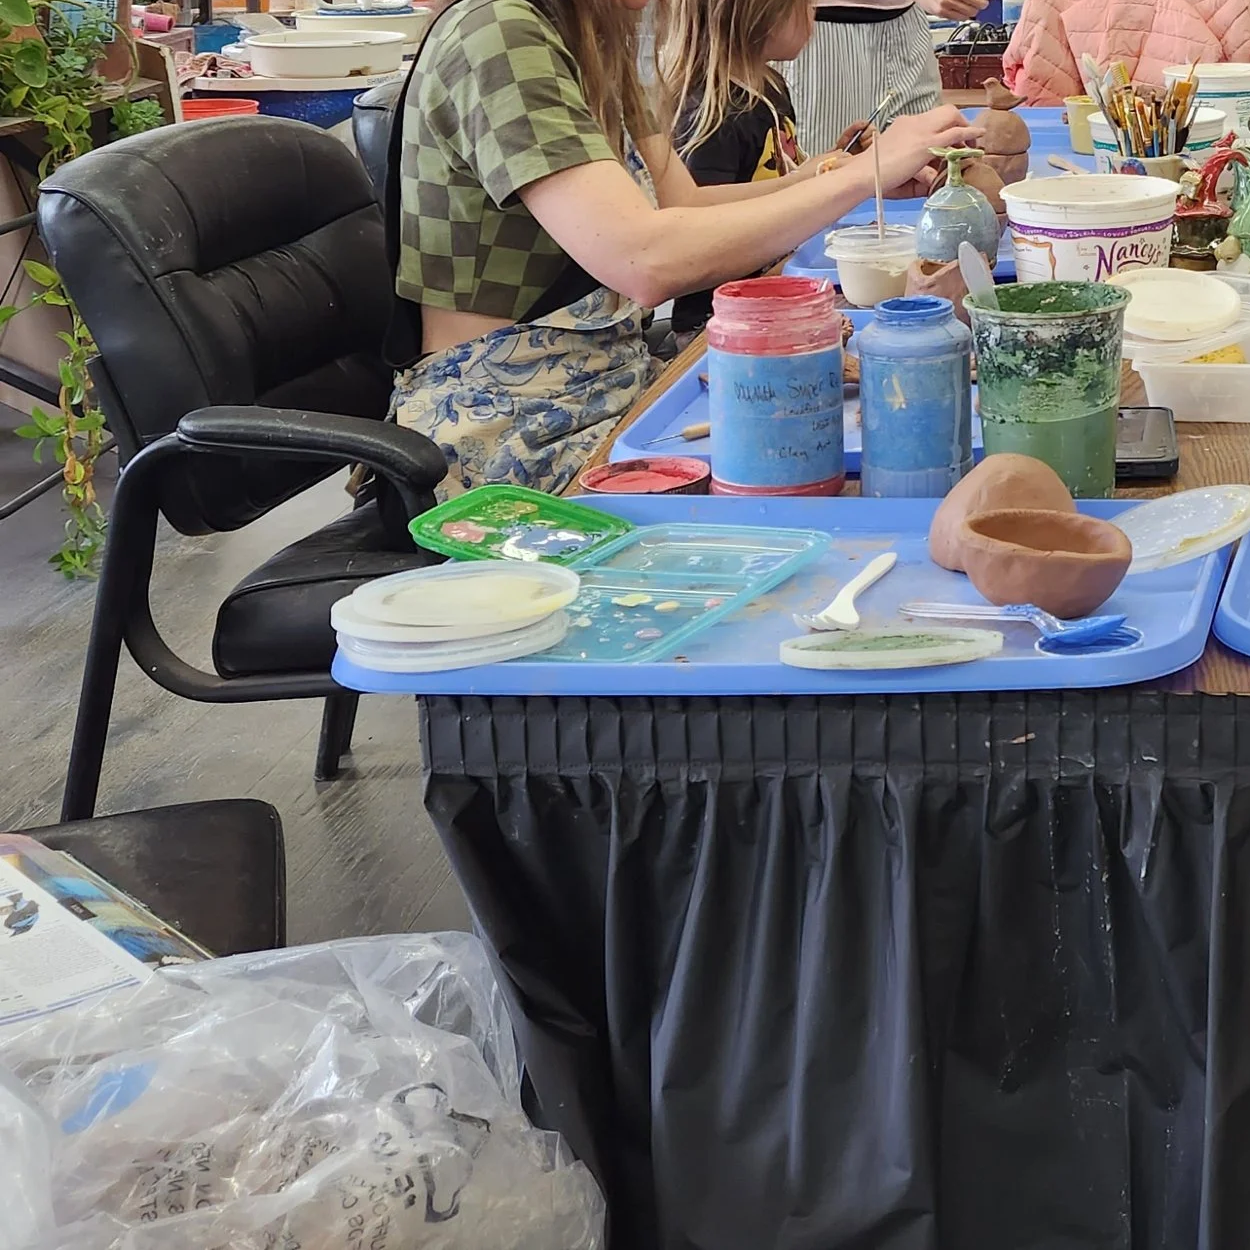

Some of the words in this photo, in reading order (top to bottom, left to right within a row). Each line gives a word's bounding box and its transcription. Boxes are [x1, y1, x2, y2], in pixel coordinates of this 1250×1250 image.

[1095, 240, 1161, 282] Nancy's
[786, 376, 823, 400] Super
[779, 445, 808, 460] Clay
